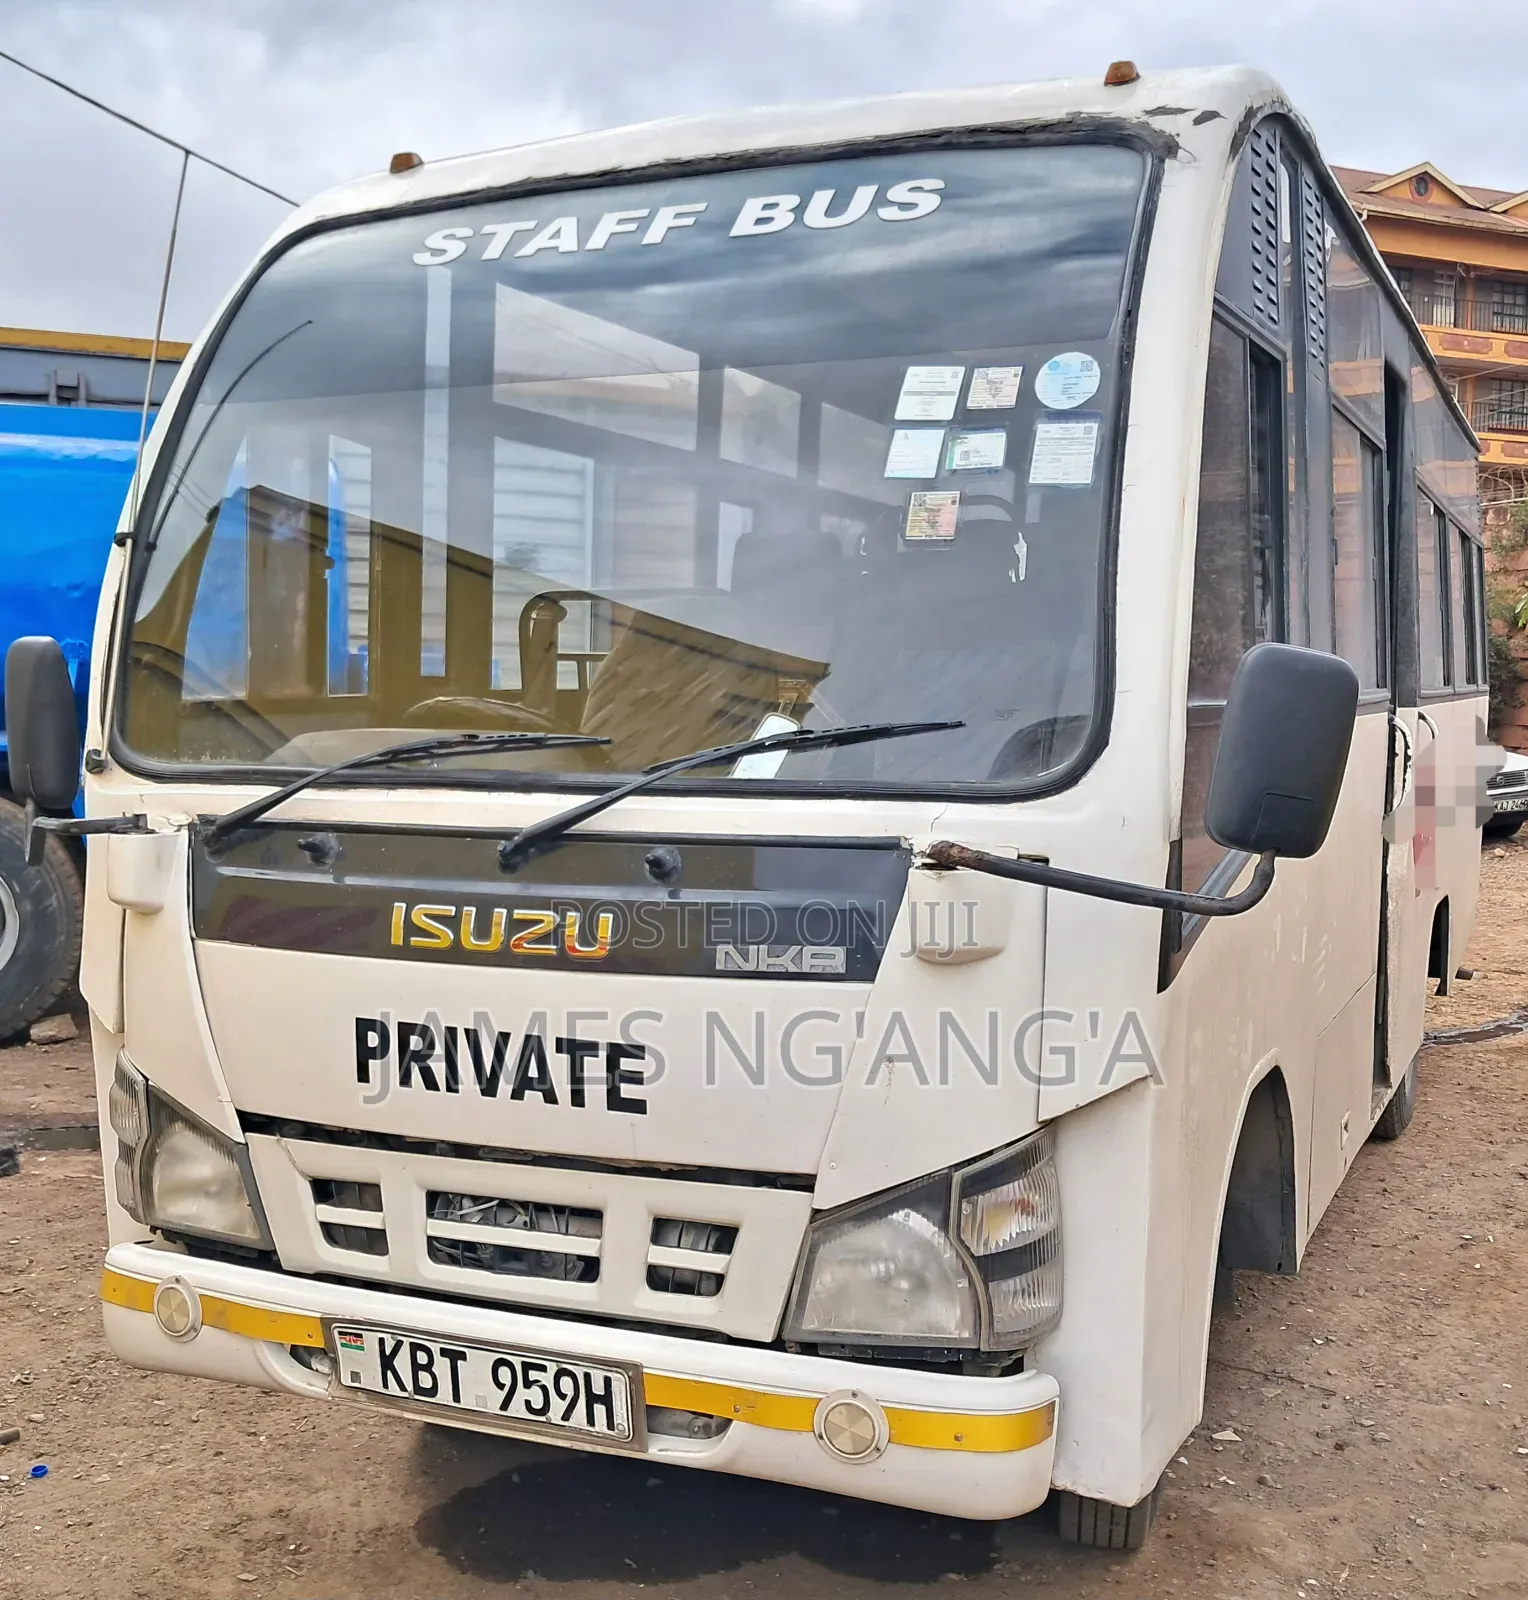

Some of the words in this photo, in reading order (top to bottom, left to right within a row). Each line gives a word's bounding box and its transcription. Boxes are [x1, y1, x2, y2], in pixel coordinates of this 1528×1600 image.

[412, 202, 707, 266] STAFF
[728, 178, 946, 238] BUS
[390, 902, 614, 960] ISUZU
[715, 944, 847, 974] NKR
[355, 1016, 648, 1116] PRIVATE
[378, 1337, 467, 1404] KBT
[491, 1356, 616, 1432] 959H
